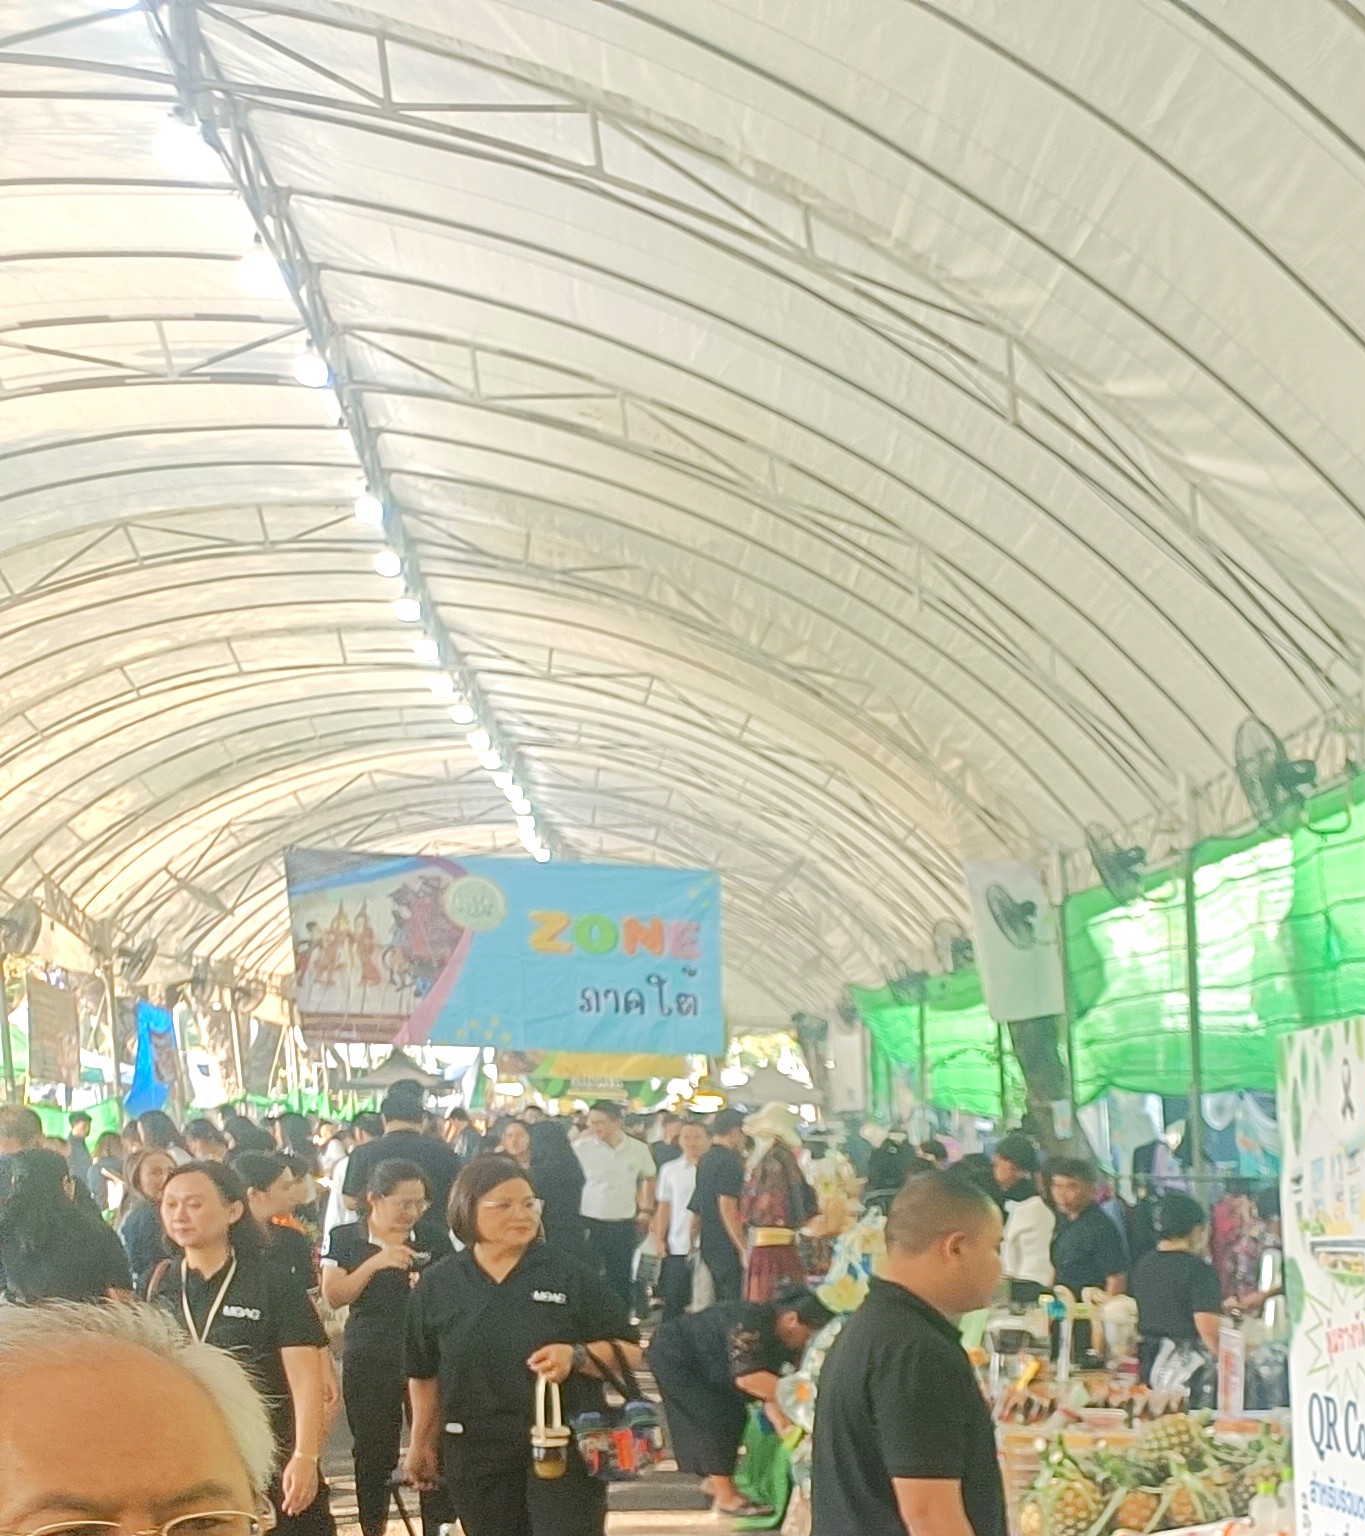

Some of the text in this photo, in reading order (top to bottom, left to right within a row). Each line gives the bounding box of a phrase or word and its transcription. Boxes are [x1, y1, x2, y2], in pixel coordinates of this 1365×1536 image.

[527, 910, 704, 960] ZONE
[578, 965, 699, 1017] ภาคใต้
[1309, 1392, 1340, 1461] QR
